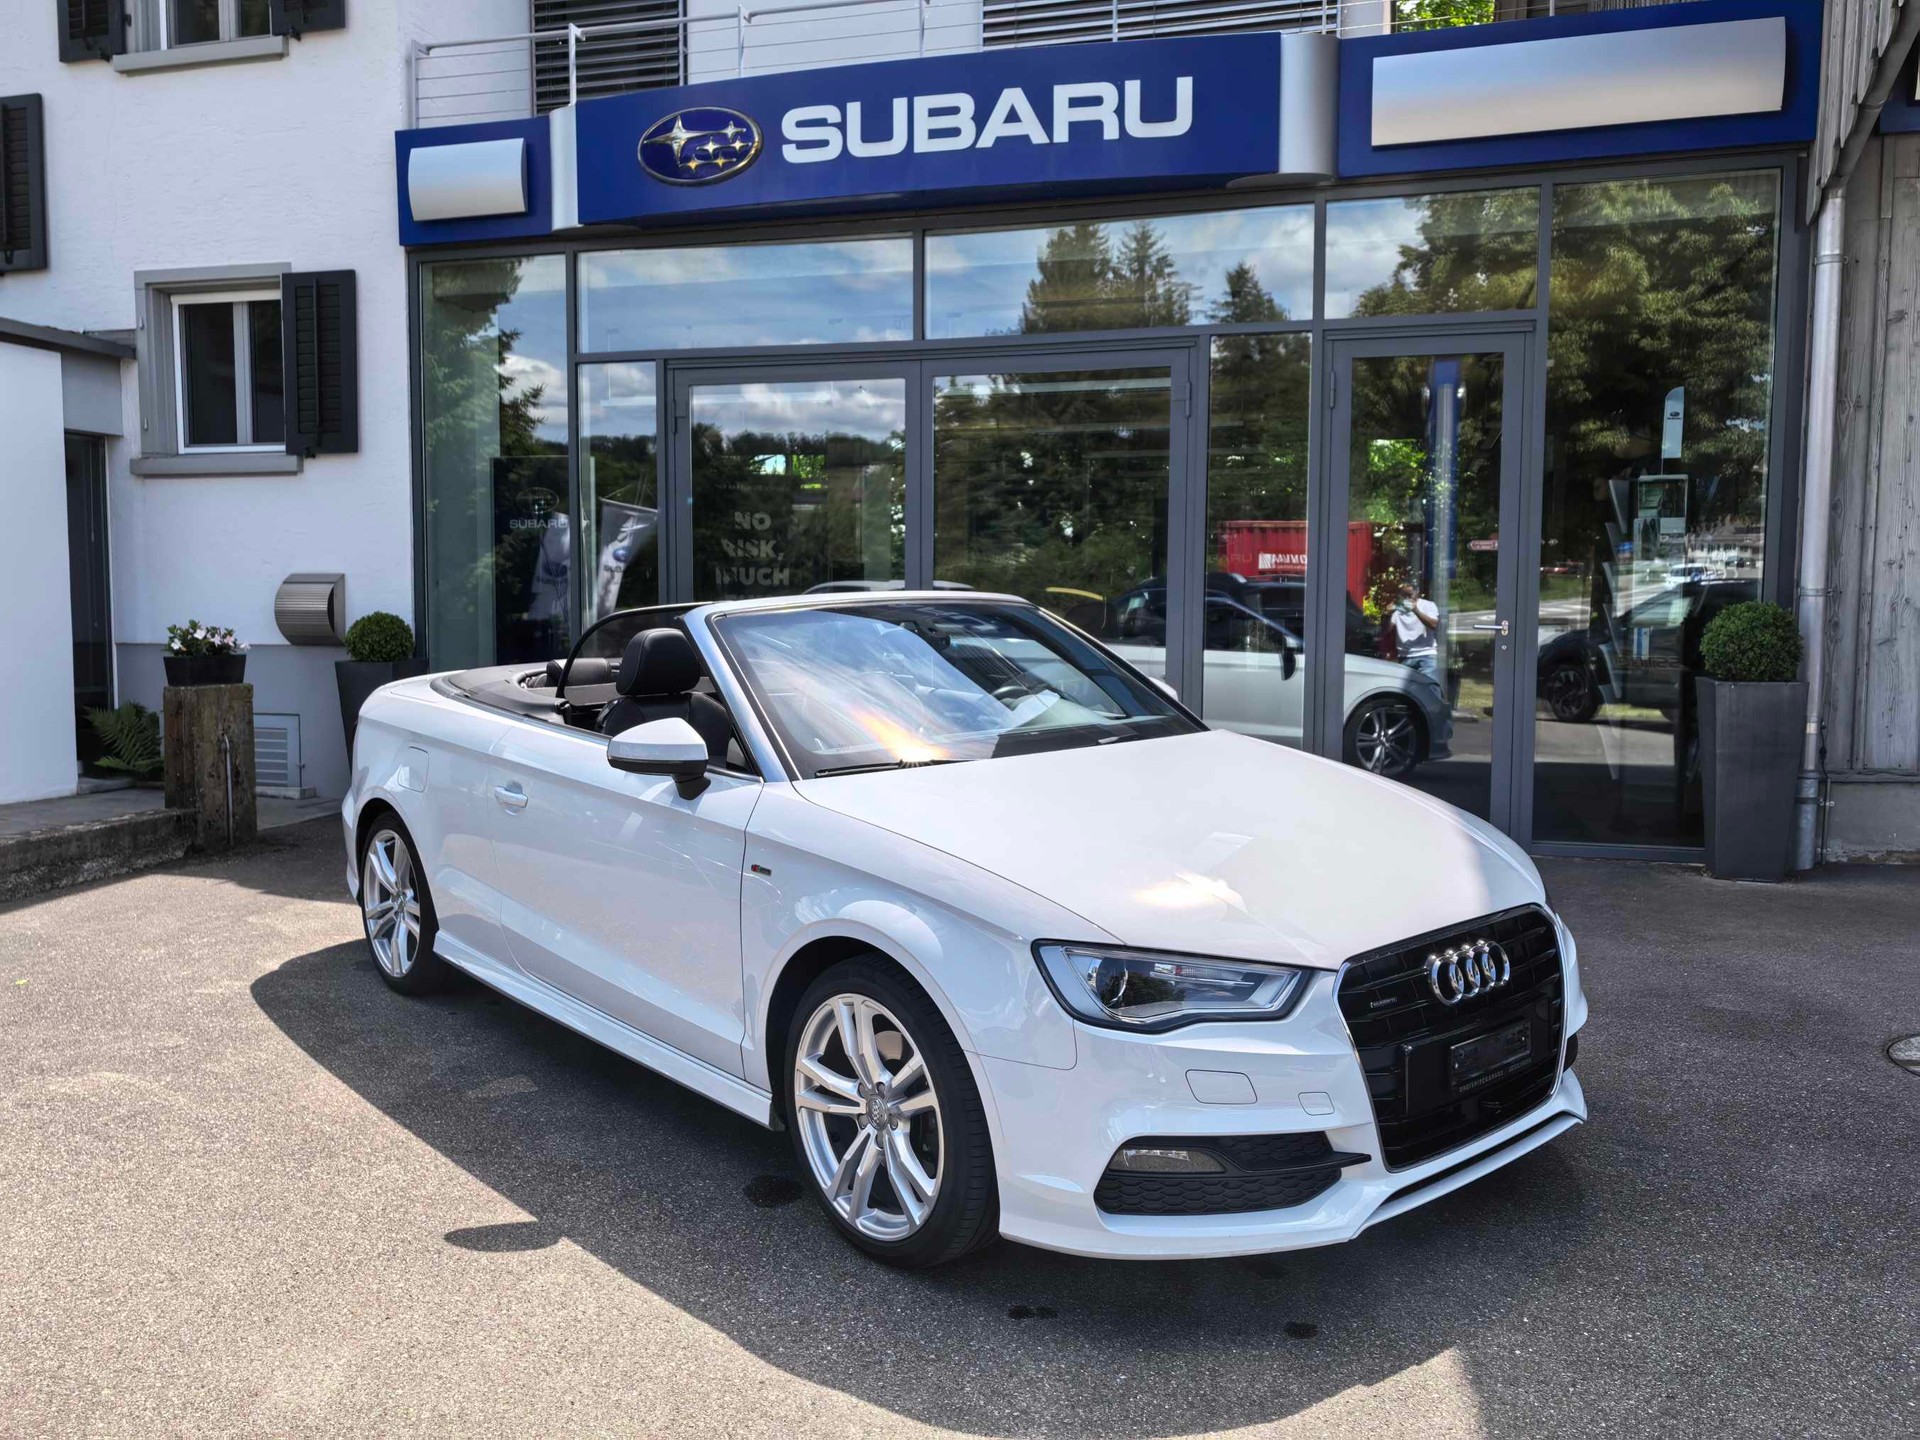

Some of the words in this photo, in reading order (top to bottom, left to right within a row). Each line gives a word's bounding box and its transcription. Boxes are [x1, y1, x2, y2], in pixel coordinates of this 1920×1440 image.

[781, 76, 1193, 164] SUBARU
[509, 518, 569, 529] SUBARU
[734, 511, 772, 531] NO
[720, 538, 785, 562] RISK,
[715, 567, 790, 586] MUCH
